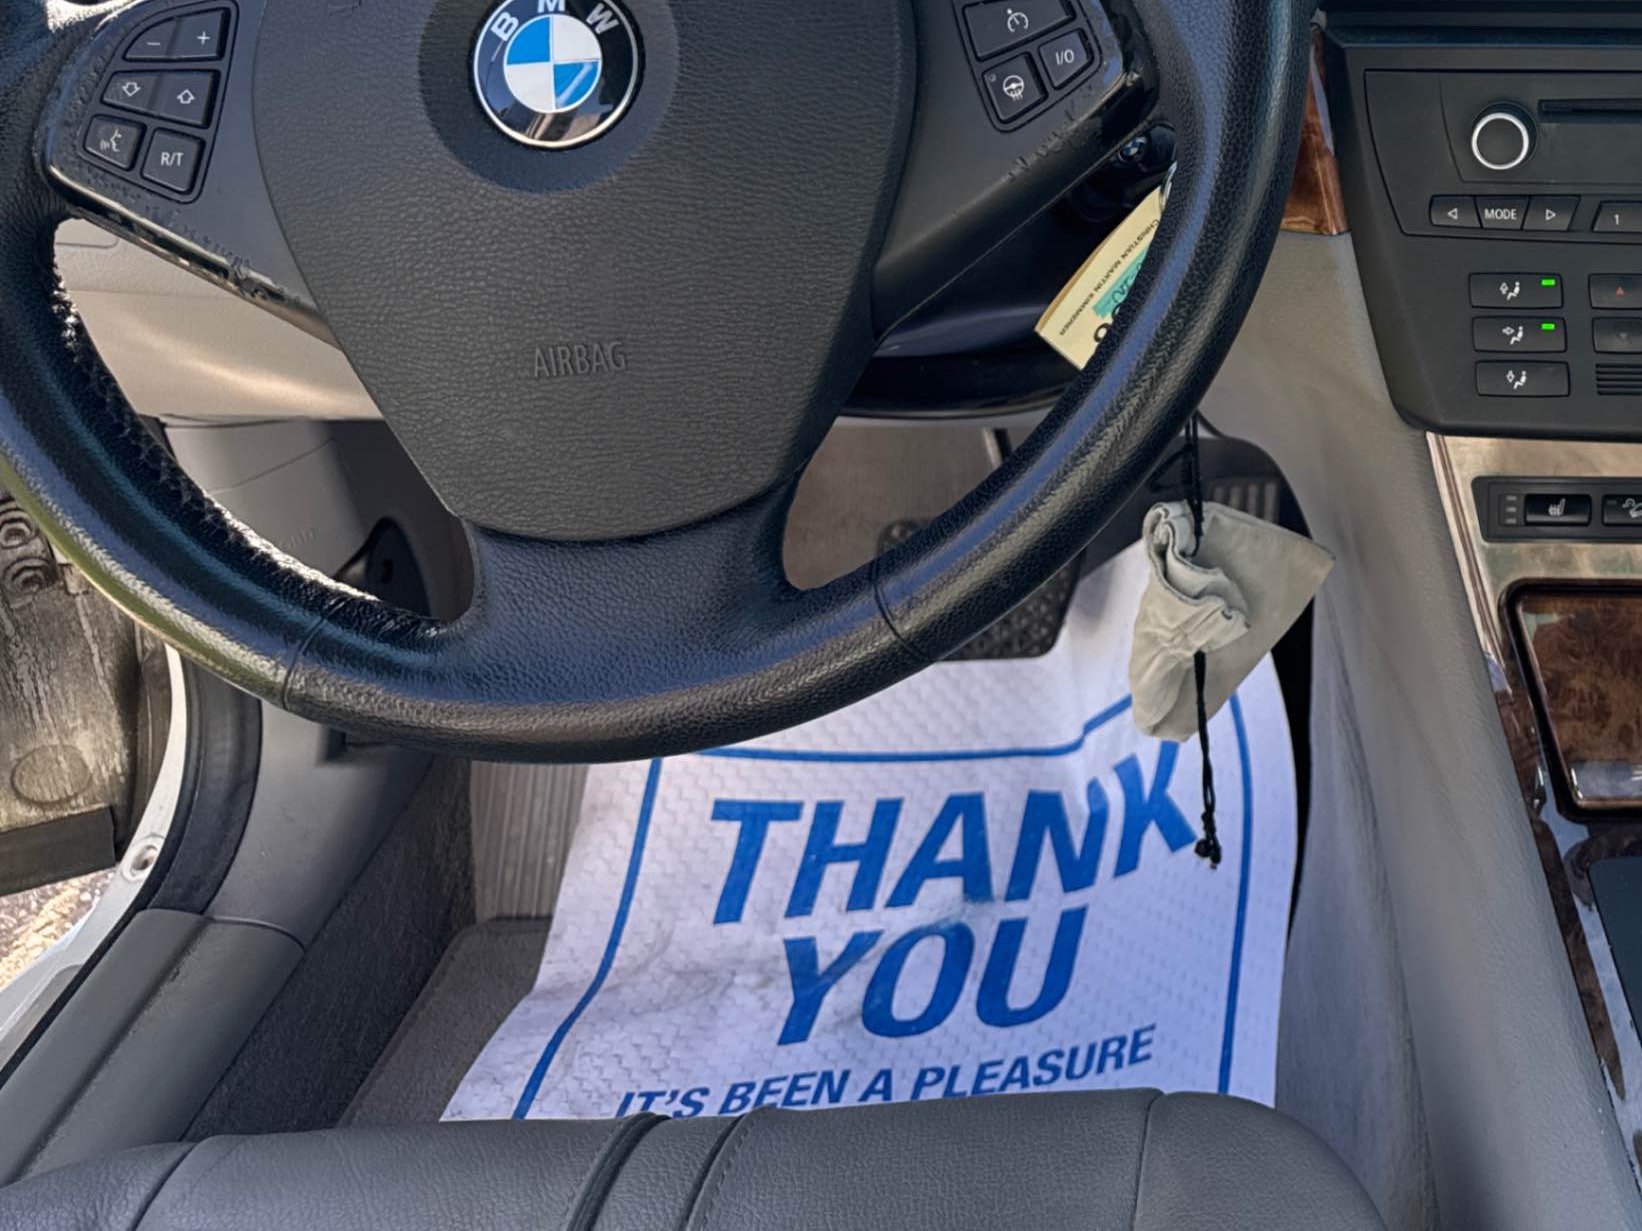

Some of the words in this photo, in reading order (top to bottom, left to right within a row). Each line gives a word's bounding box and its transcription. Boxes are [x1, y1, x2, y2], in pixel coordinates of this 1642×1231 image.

[159, 152, 184, 167] R/T
[1484, 208, 1517, 220] MODE
[1613, 214, 1620, 225] 1
[533, 341, 628, 378] AIRBAG
[710, 741, 1197, 925] THANK
[776, 908, 1088, 1046] YOU
[614, 1085, 709, 1119] IT'S
[718, 1068, 851, 1116] BEEN
[858, 1067, 894, 1103] A
[910, 1023, 1157, 1101] PLEASURE
